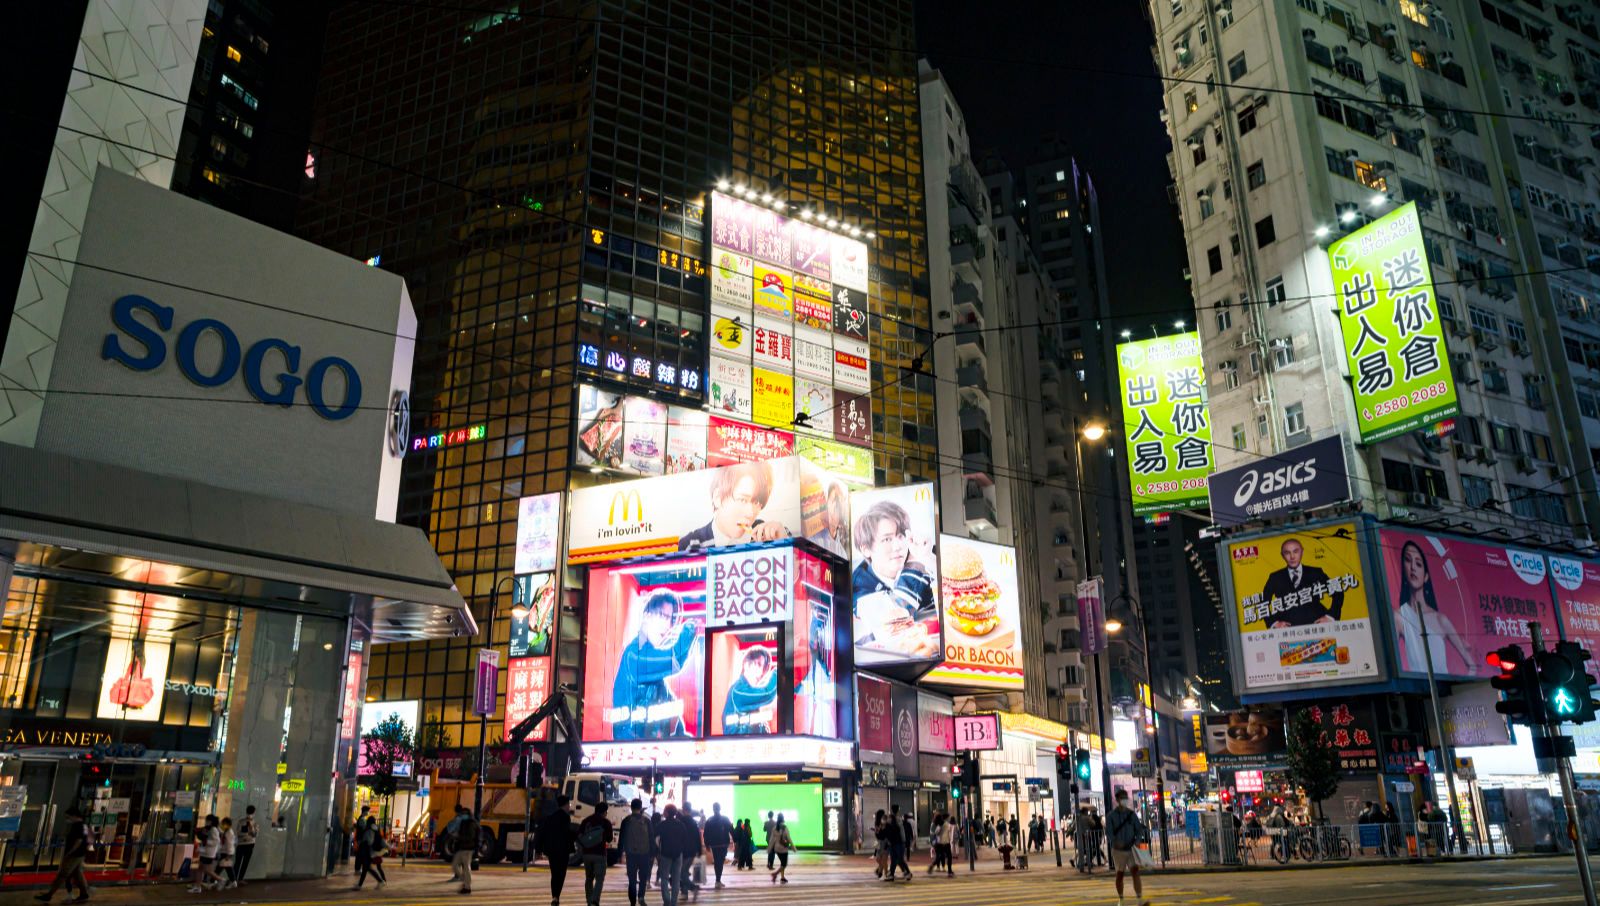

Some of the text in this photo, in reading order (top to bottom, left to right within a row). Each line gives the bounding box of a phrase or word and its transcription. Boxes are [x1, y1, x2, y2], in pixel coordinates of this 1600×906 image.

[1362, 222, 1415, 256] STORAGE
[1383, 249, 1439, 381] 迷你倉
[755, 327, 792, 361] 金羅寶
[1343, 272, 1393, 394] 出入易
[101, 293, 363, 422] SOGO
[1375, 396, 1408, 417] 2580
[1412, 382, 1447, 404] 2088
[1127, 376, 1167, 474] 出入易
[1166, 368, 1209, 470] 迷你倉
[1147, 477, 1208, 494] 2580 208
[1259, 458, 1317, 494] asics
[1253, 488, 1310, 514] 崇光百貨4樓
[597, 528, 613, 539] i'm
[714, 555, 787, 581] BACON
[1512, 553, 1543, 571] Circle
[1551, 560, 1581, 577] Circle
[714, 574, 787, 600] BACON
[1243, 573, 1359, 625] 馬百良安宮牛黃丸
[714, 593, 787, 619] BACON
[946, 645, 1015, 666] OR BACON
[513, 669, 545, 690] 麻辣
[865, 693, 885, 716] Sasa
[37, 729, 113, 747] VENETA
[964, 721, 985, 742] iB
[420, 756, 443, 770] Sasa
